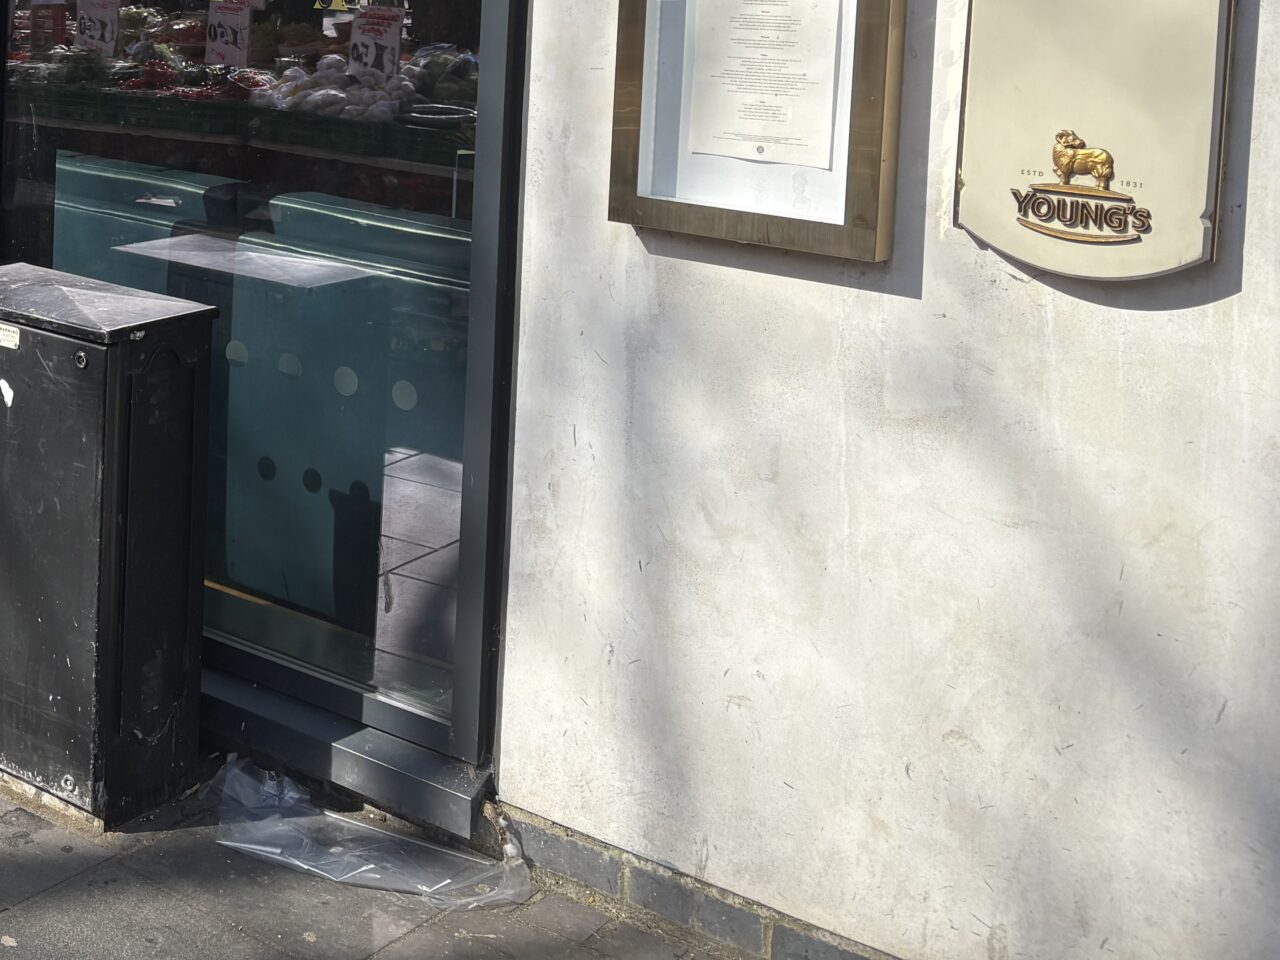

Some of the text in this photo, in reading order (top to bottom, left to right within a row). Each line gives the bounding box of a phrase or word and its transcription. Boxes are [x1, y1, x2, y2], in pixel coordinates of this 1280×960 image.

[1020, 169, 1044, 177] ESTD
[1120, 180, 1144, 189] 1831
[1010, 188, 1152, 234] YOUNG'S
